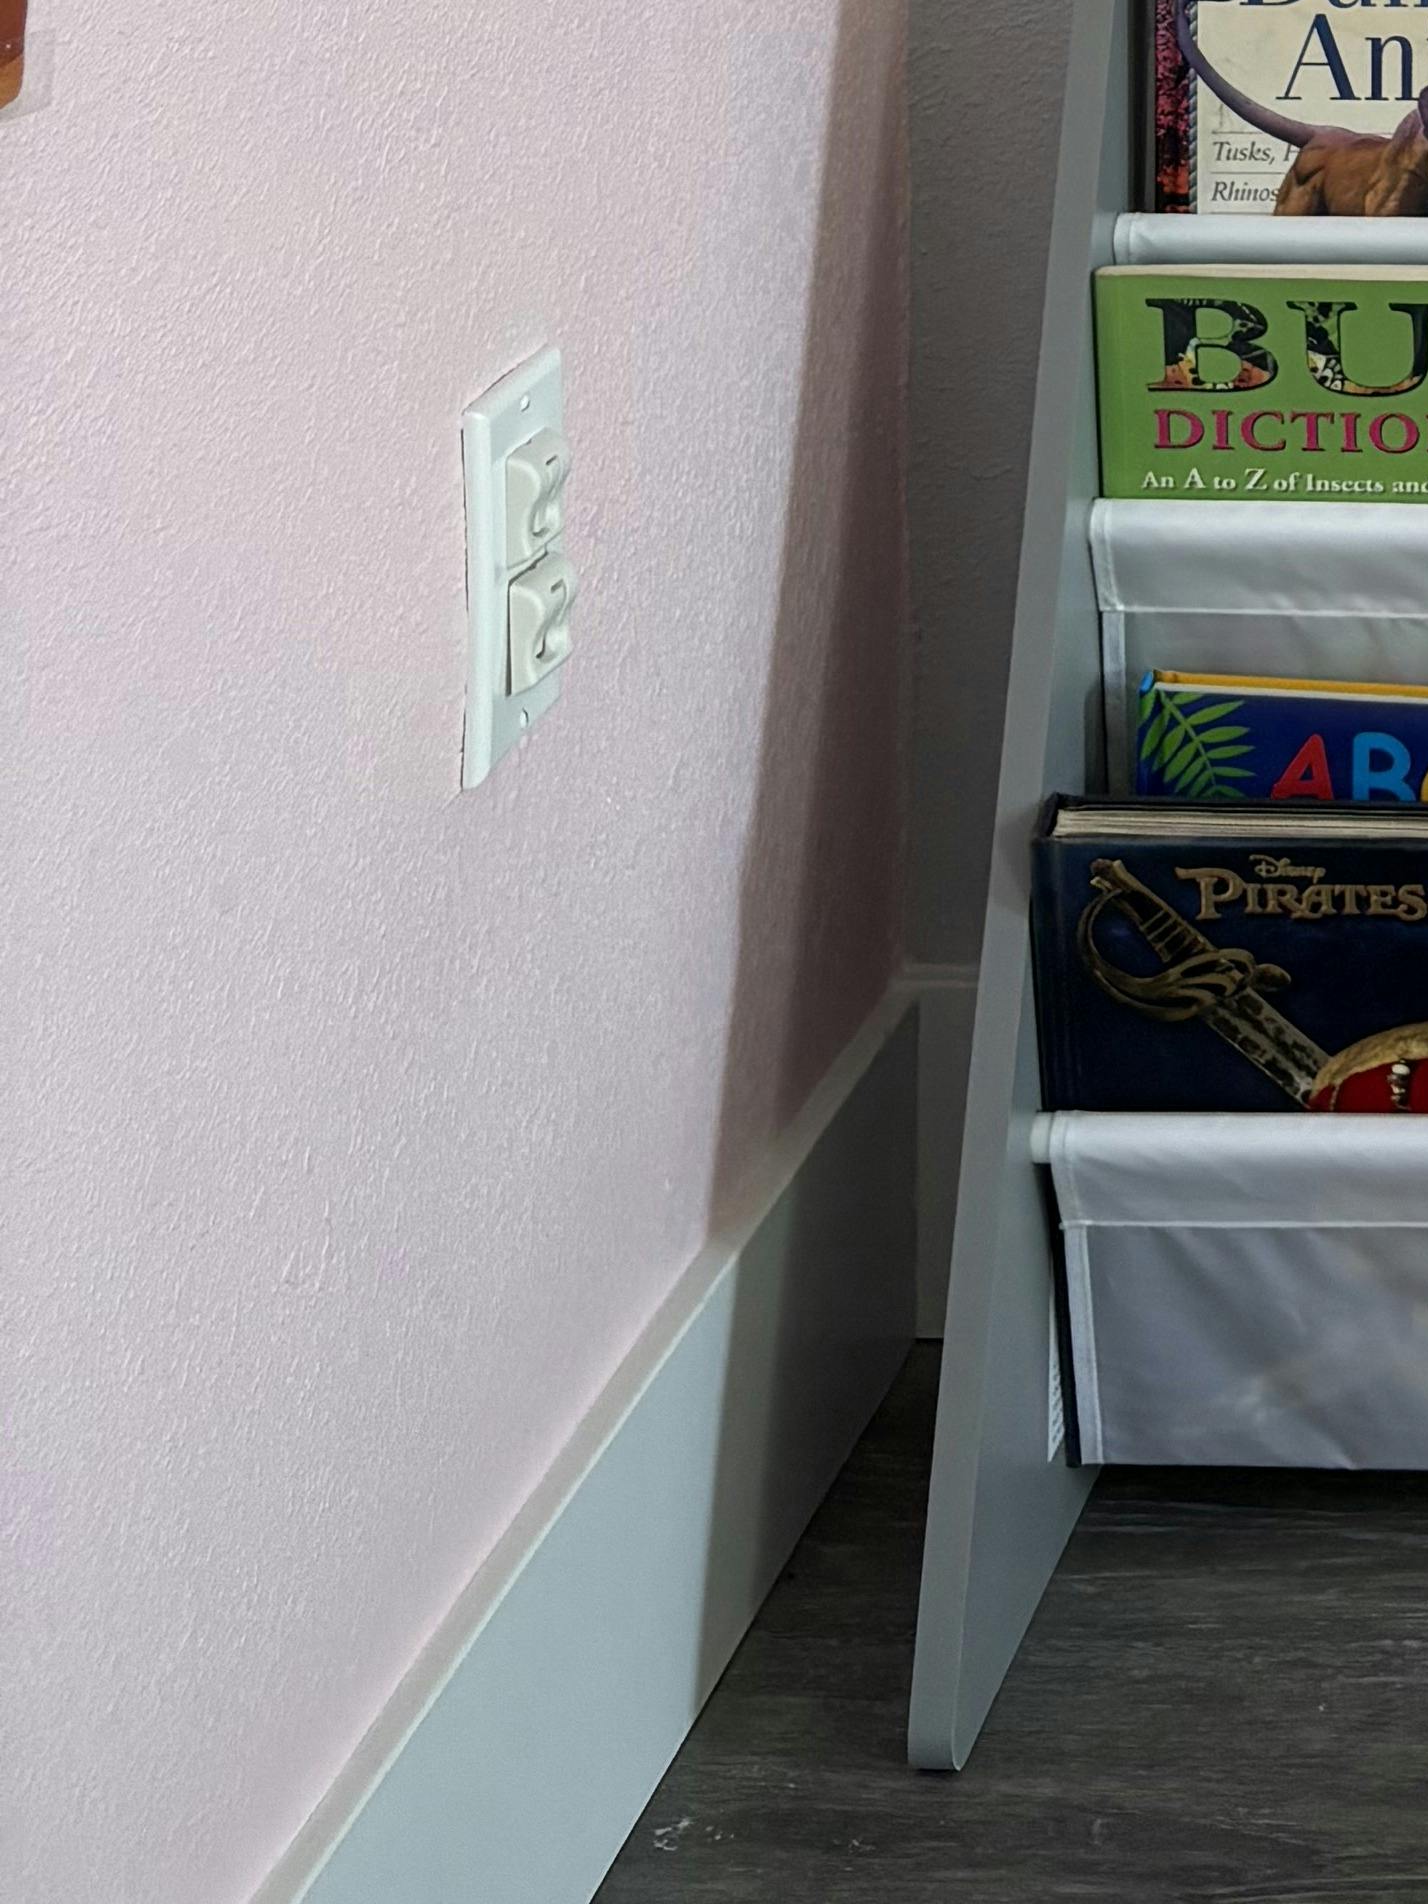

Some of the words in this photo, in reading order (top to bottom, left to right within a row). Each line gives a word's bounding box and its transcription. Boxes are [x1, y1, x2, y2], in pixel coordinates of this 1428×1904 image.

[1212, 142, 1276, 164] Tusks,
[1141, 471, 1175, 489] An
[1182, 466, 1207, 489] A
[1213, 474, 1236, 490] to
[1244, 467, 1268, 491] Z
[1272, 471, 1300, 492] of
[1305, 473, 1385, 493] Insects
[1174, 866, 1428, 922] PIRATES
